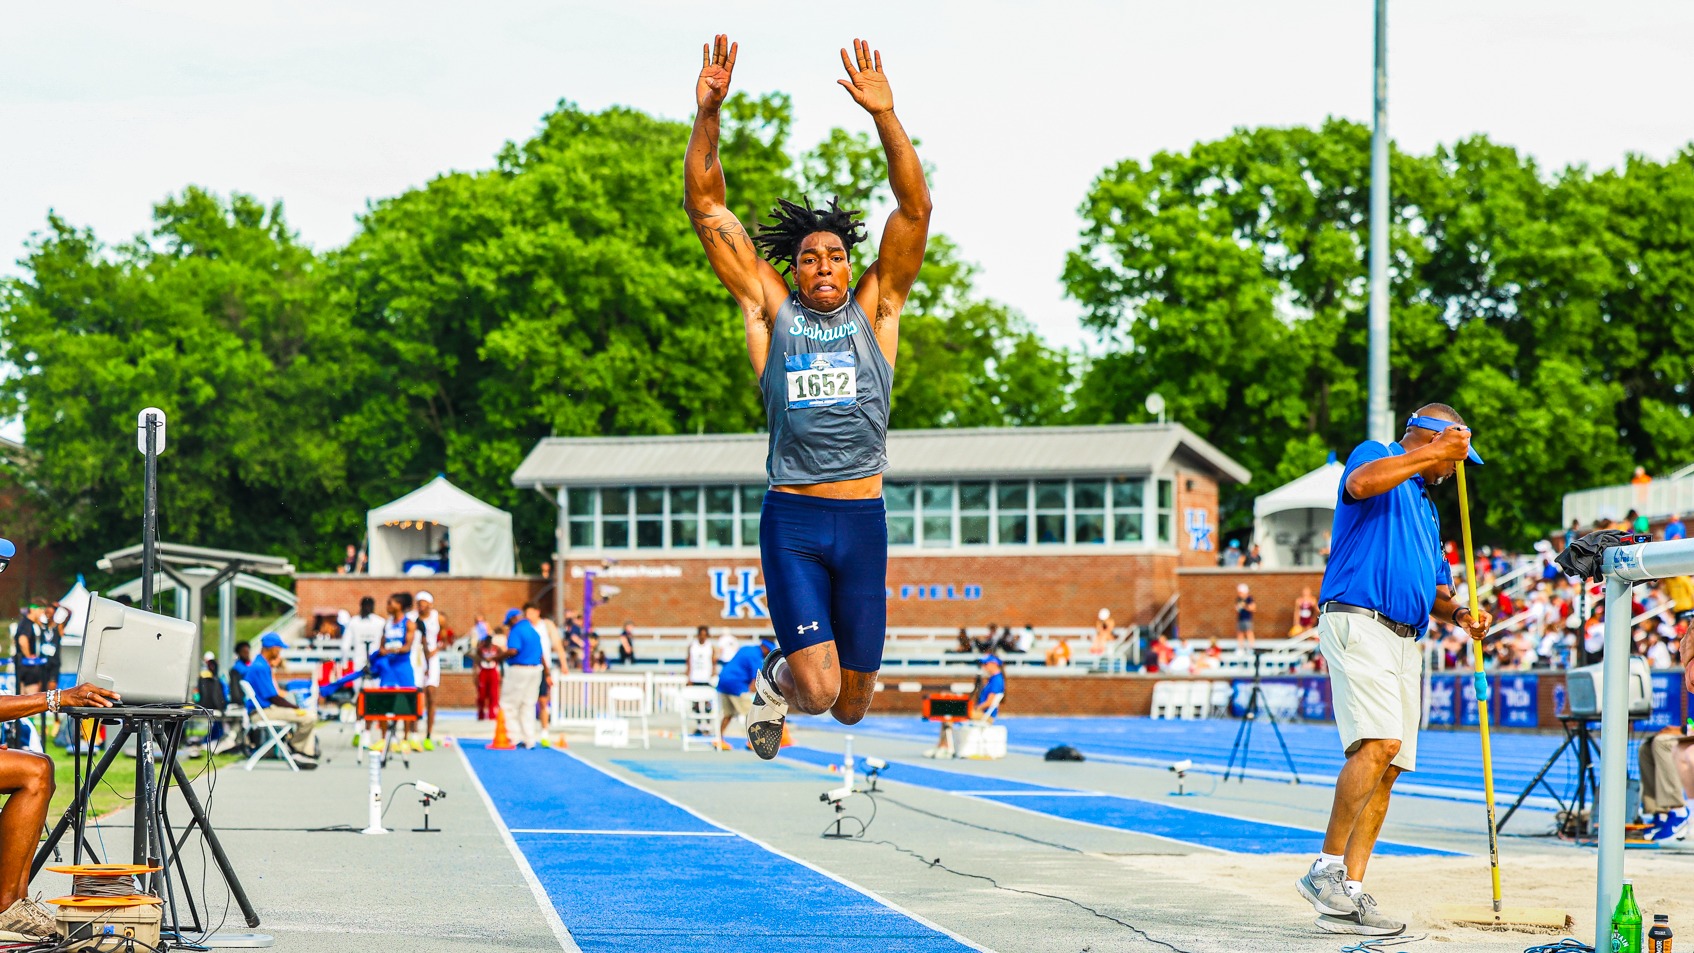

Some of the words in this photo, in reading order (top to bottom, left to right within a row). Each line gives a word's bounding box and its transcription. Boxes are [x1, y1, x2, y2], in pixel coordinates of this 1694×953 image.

[795, 372, 850, 398] 1652
[1184, 508, 1214, 551] UK
[707, 566, 769, 620] UK
[900, 583, 982, 600] FIELD
[762, 689, 782, 707] UNDER
